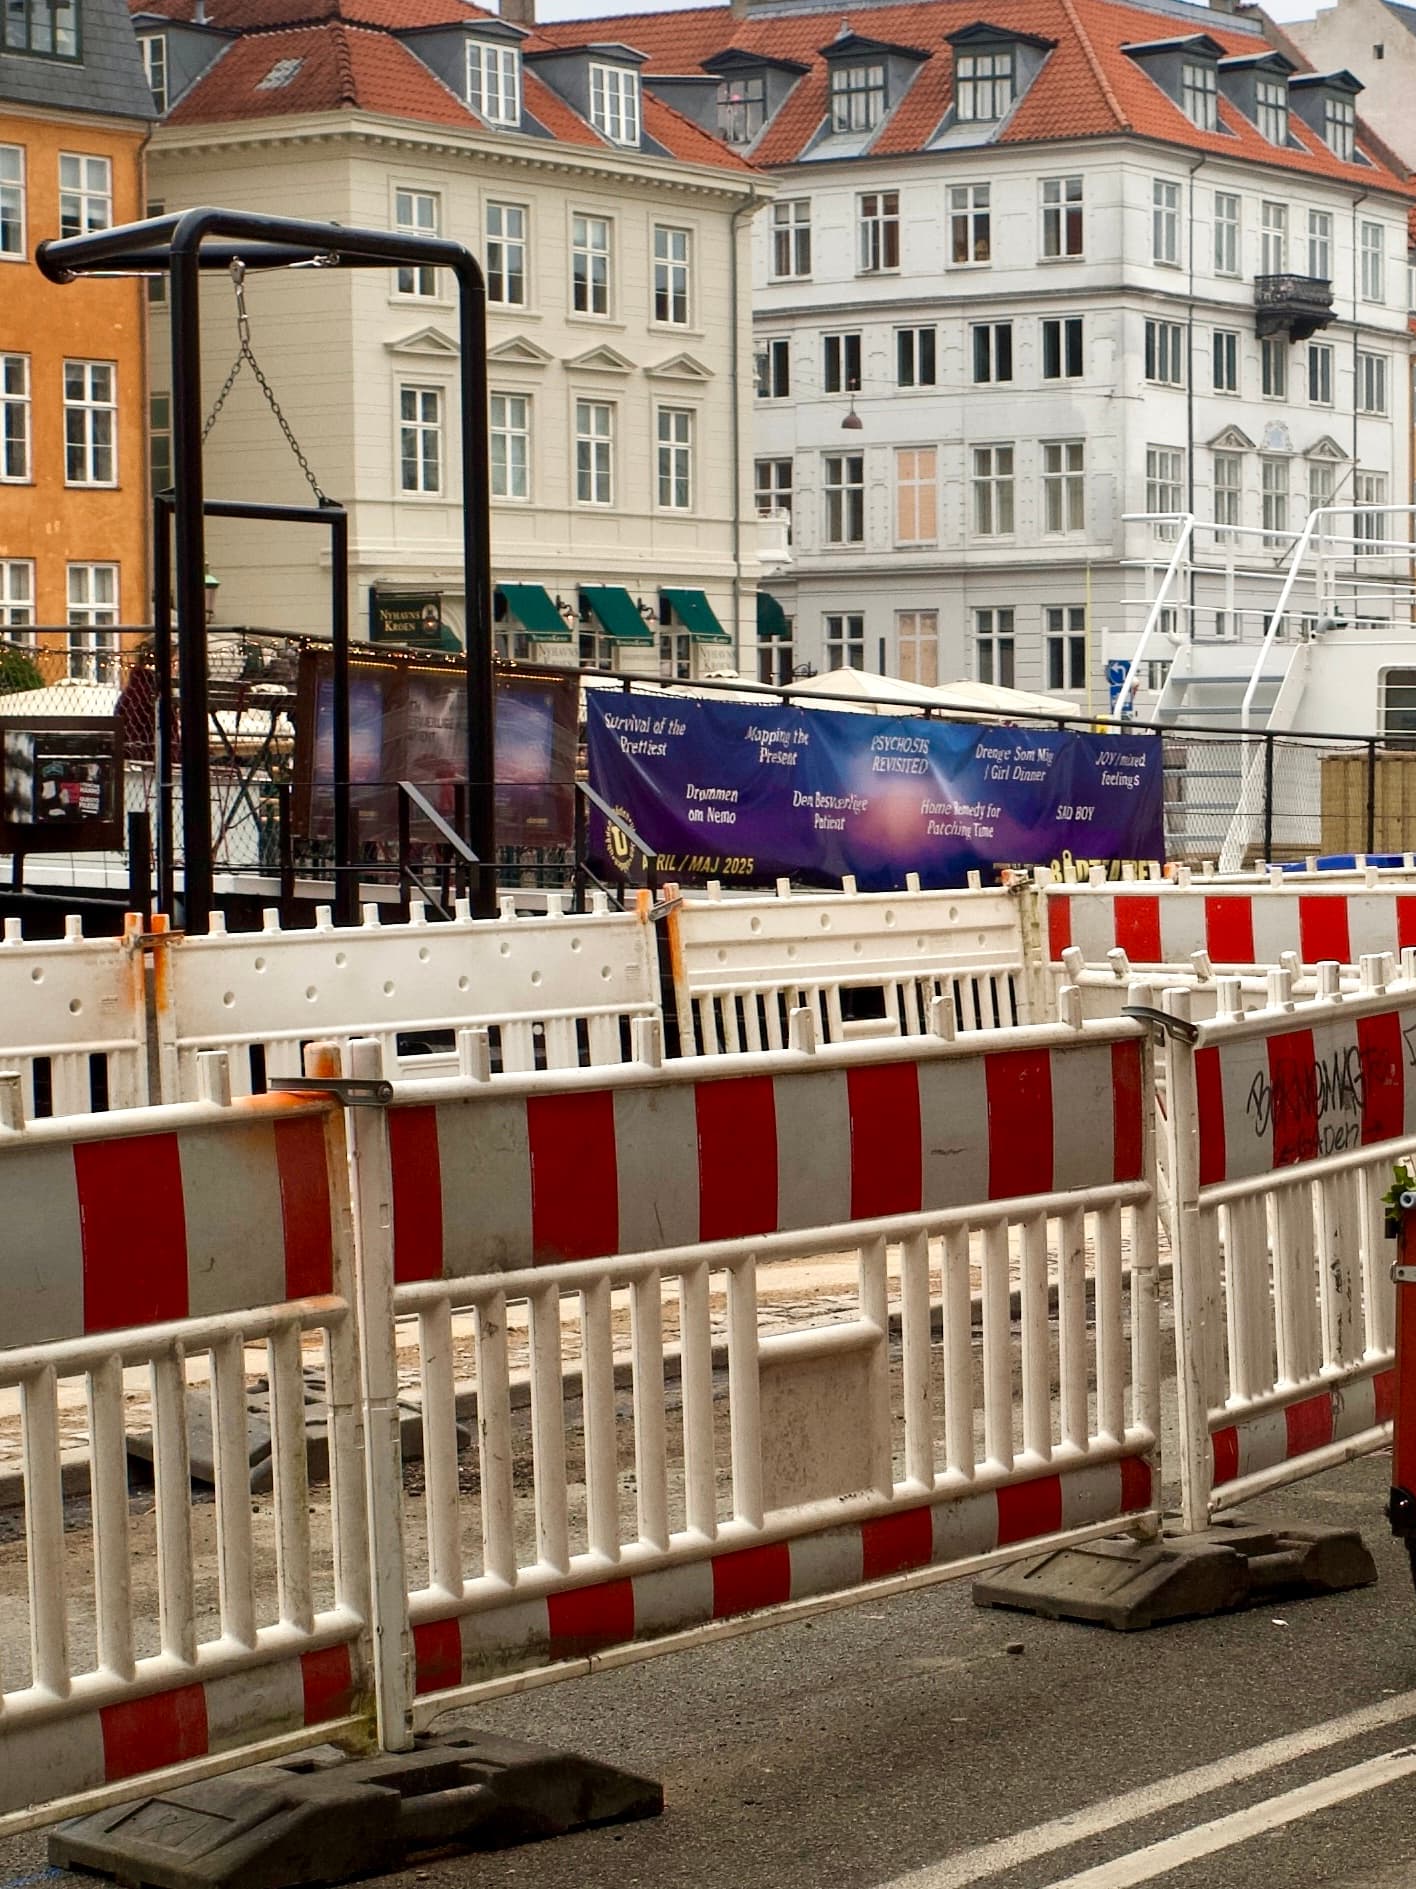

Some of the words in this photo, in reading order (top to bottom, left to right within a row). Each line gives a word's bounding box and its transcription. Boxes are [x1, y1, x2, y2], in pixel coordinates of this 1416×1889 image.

[380, 608, 420, 621] NYHAVNS
[384, 620, 417, 632] KROEN
[604, 713, 650, 733] Survival
[653, 717, 667, 735] of
[668, 719, 686, 736] the
[621, 736, 667, 757] Prettiest
[745, 726, 790, 748] Mapping
[793, 727, 809, 745] the
[871, 735, 930, 754] PSYCHOSIS
[759, 747, 797, 766] Present
[975, 743, 1010, 762] Drenge
[1014, 746, 1035, 761] Som
[1037, 748, 1054, 767] Mig
[872, 756, 929, 775] REVISITED
[991, 764, 1010, 781] Girl
[1012, 765, 1047, 782] Dinner
[1101, 771, 1140, 789] feelings
[686, 783, 738, 804] Drømmen
[793, 790, 814, 808] Den
[688, 808, 704, 822] om
[707, 806, 736, 825] Nemo
[921, 799, 950, 816] Home
[953, 800, 986, 820] Remedy
[986, 802, 1001, 818] for
[1055, 805, 1074, 821] SAD
[1075, 806, 1095, 821] BOY
[814, 813, 845, 831] Patient
[927, 819, 972, 840] Patching
[973, 822, 994, 838] Time
[642, 854, 675, 872] ARIL
[690, 855, 720, 874] MAJ
[723, 856, 754, 875] 2025
